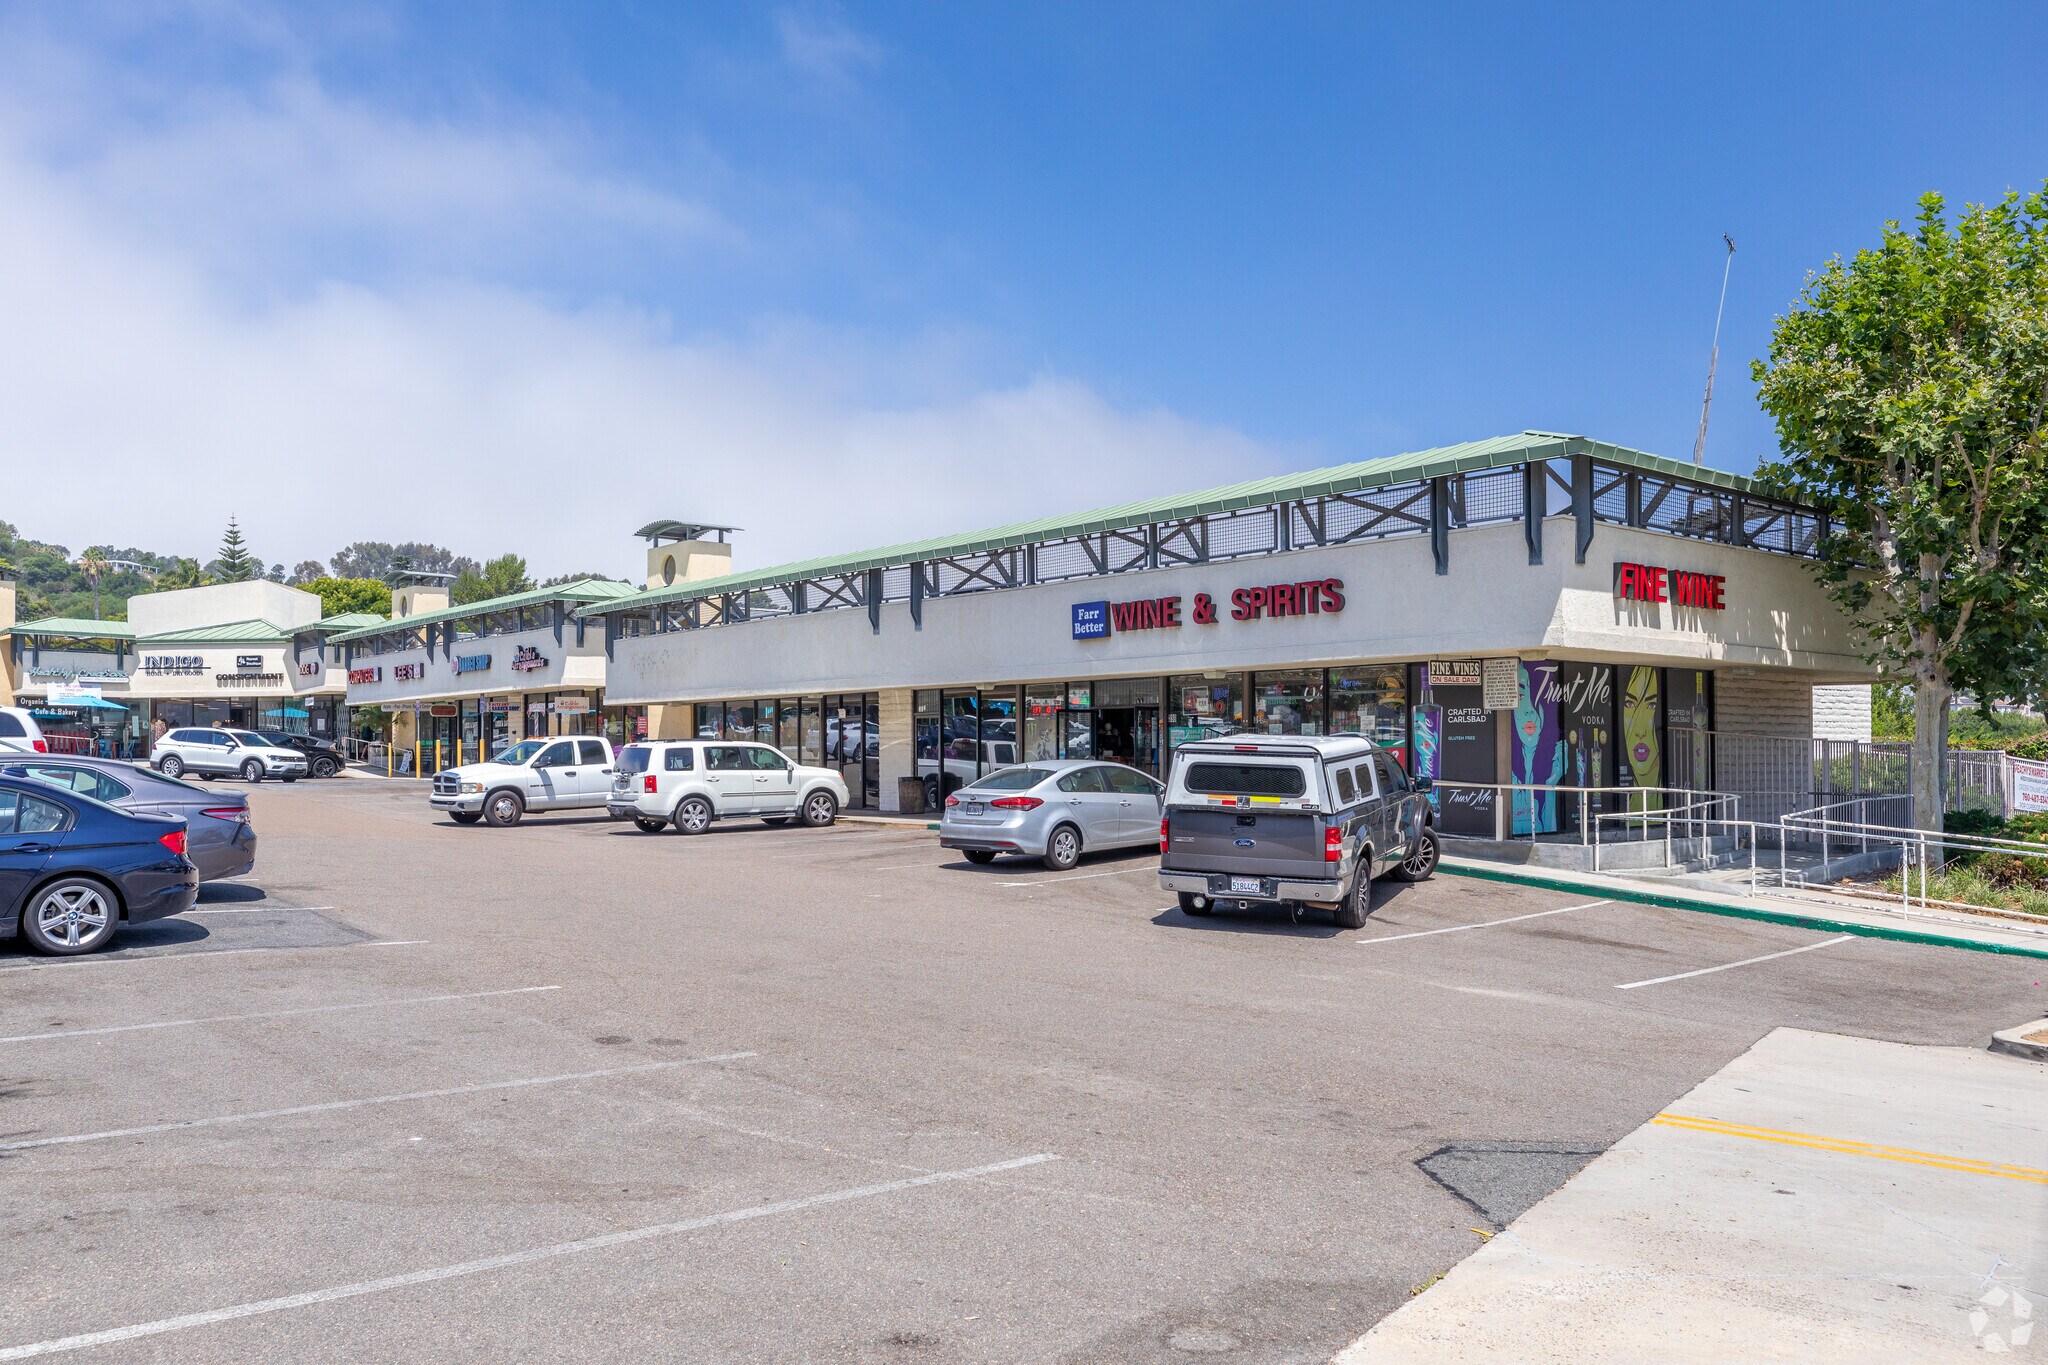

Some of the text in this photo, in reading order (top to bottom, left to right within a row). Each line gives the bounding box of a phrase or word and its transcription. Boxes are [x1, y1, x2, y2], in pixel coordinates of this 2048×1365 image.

[1617, 562, 1726, 610] FINE WINE
[1111, 578, 1345, 632] WINE & SPIRITS
[1078, 609, 1099, 620] Farr
[1074, 621, 1104, 634] Better
[144, 655, 204, 668] INDIGO
[394, 664, 413, 681] LEE'S
[1431, 661, 1480, 676] FINE WINES
[215, 672, 285, 682] CONSIGNMENT
[1432, 676, 1441, 684] ON
[1461, 675, 1479, 683] DAILY
[1533, 665, 1586, 708] Trust
[1572, 666, 1610, 713] Me
[20, 698, 44, 706] Organic
[57, 708, 78, 717] Bakery
[1447, 708, 1481, 716] CRAFTED
[1581, 716, 1605, 725] VODKA
[1448, 788, 1492, 807] Trust Me
[1232, 881, 1259, 892] 51844C2
